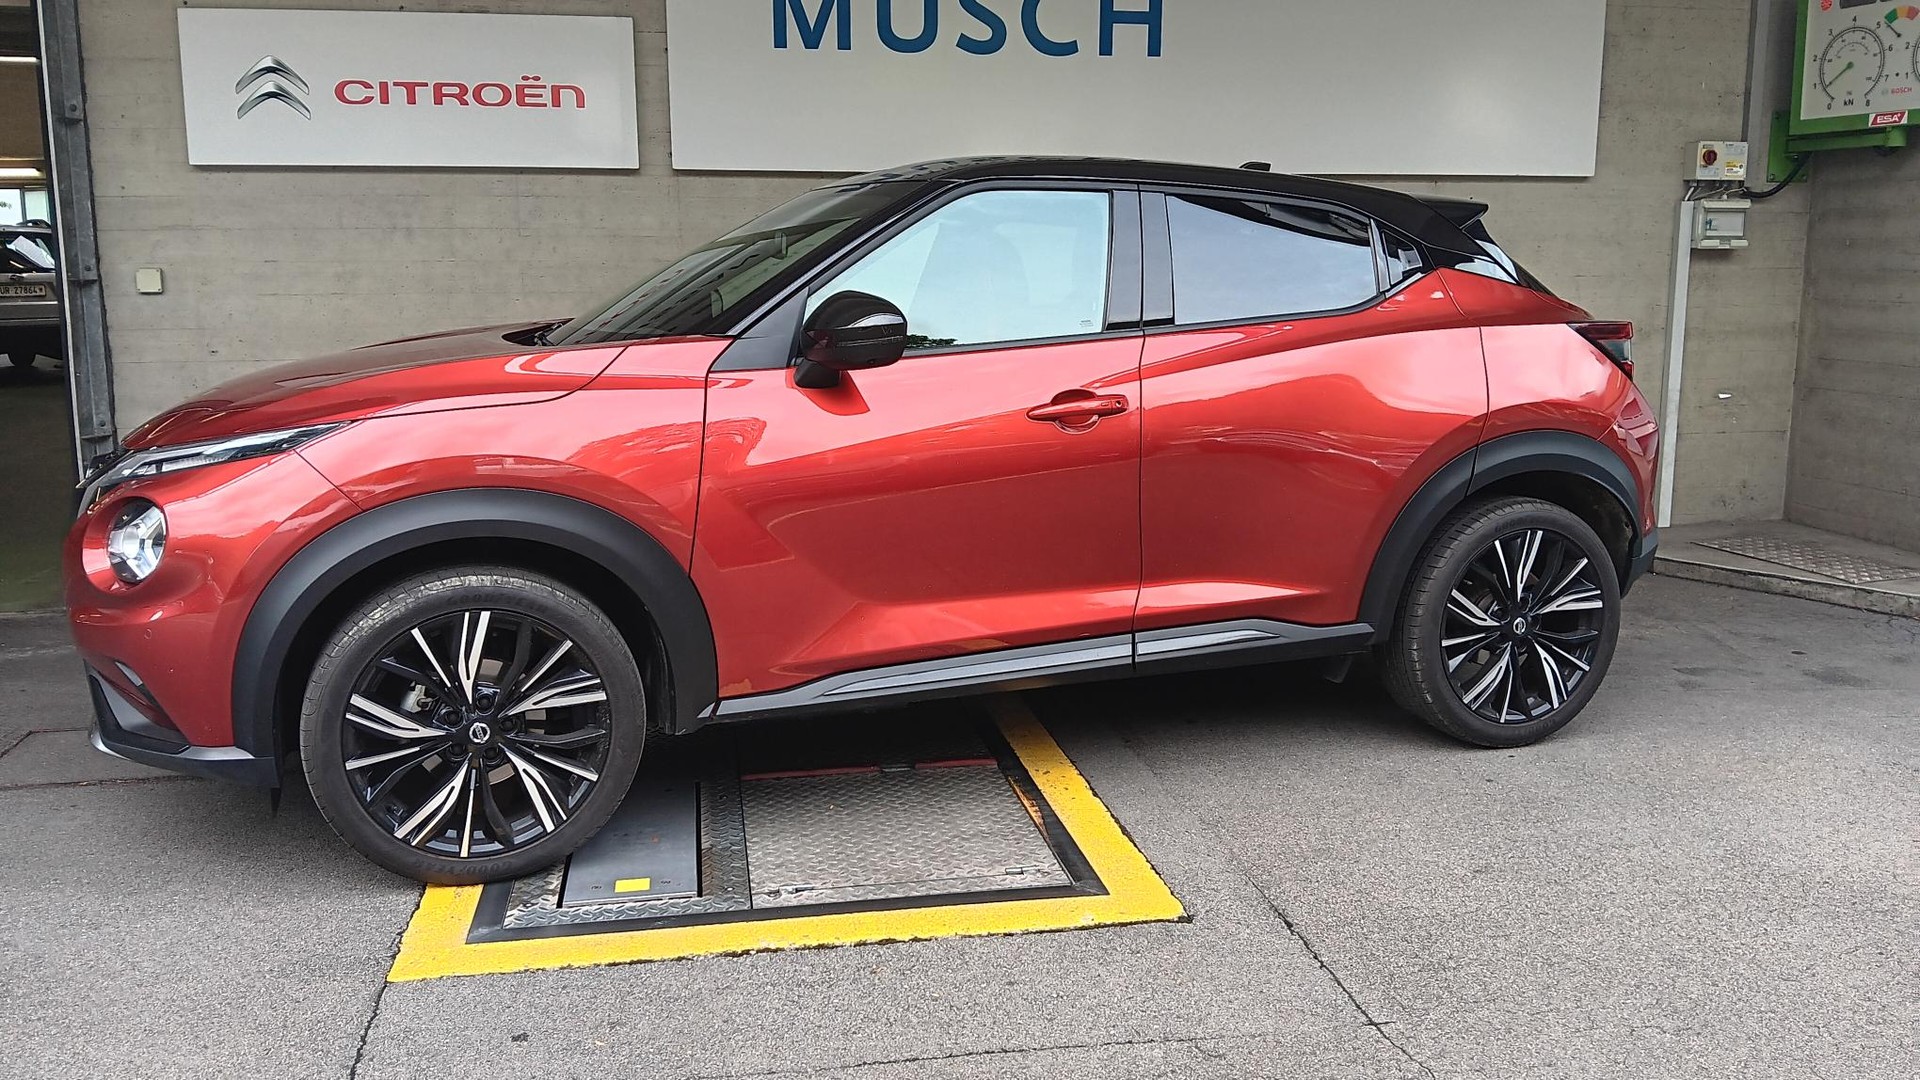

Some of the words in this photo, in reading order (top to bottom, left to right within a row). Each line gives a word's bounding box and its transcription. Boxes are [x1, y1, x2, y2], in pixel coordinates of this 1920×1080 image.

[773, 0, 1162, 57] MUSCH
[1890, 86, 1912, 94] BOSCH
[1843, 98, 1854, 106] kN
[1876, 114, 1900, 124] ESA
